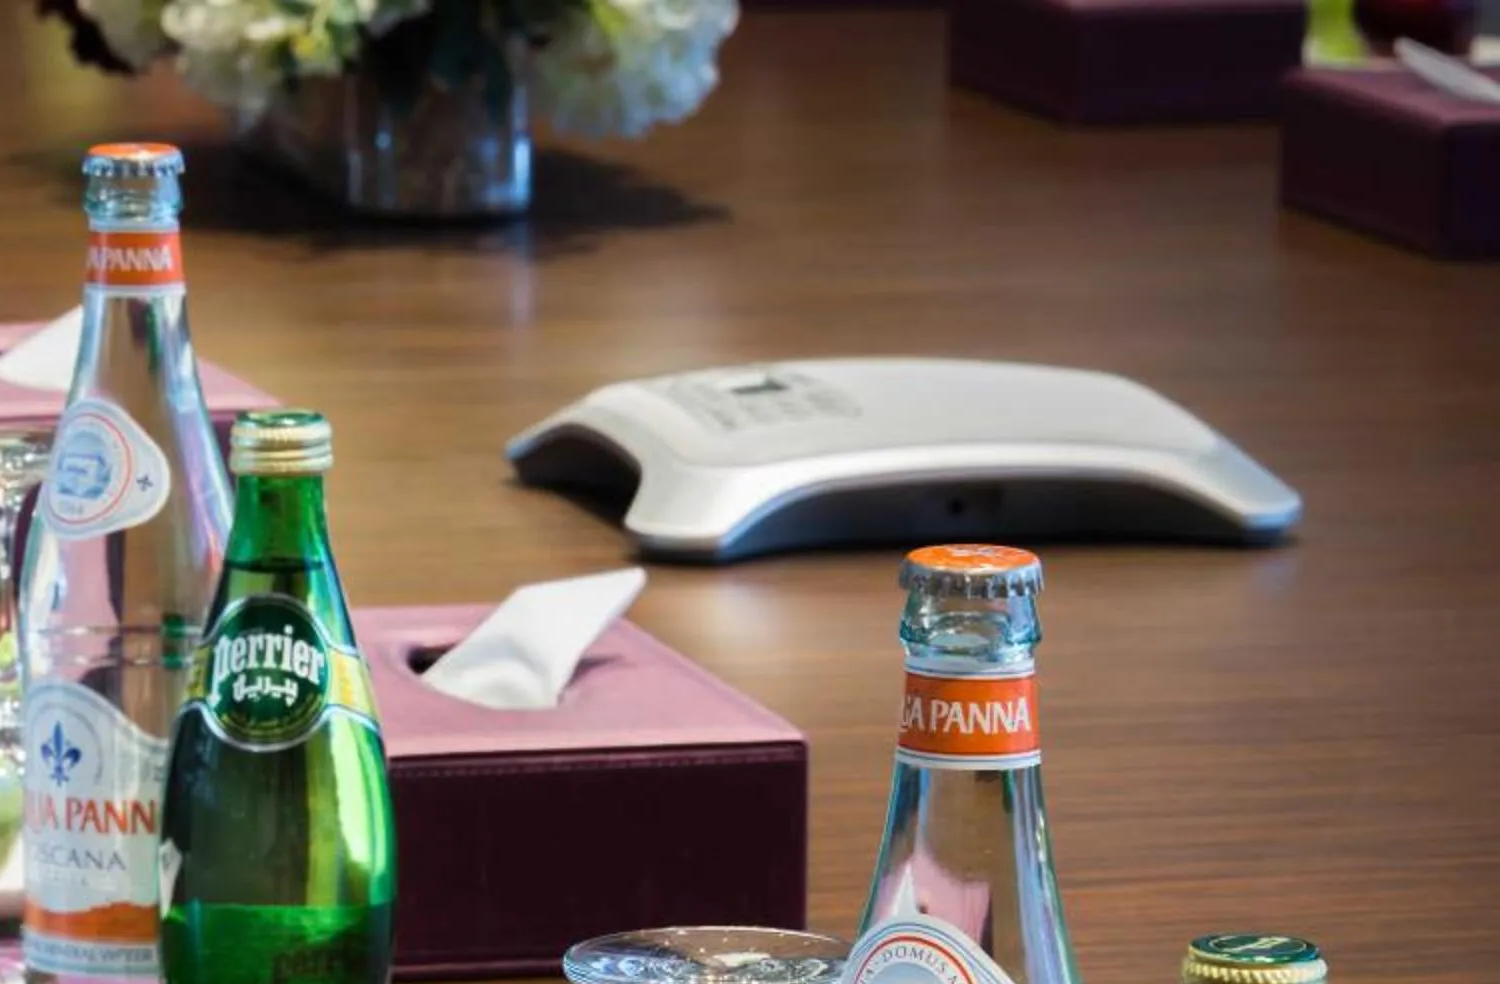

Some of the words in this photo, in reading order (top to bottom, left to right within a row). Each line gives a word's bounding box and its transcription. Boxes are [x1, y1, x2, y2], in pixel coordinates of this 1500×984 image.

[930, 696, 1032, 735] PANNA
[65, 797, 157, 836] PANN
[882, 945, 947, 974] DOMUS
